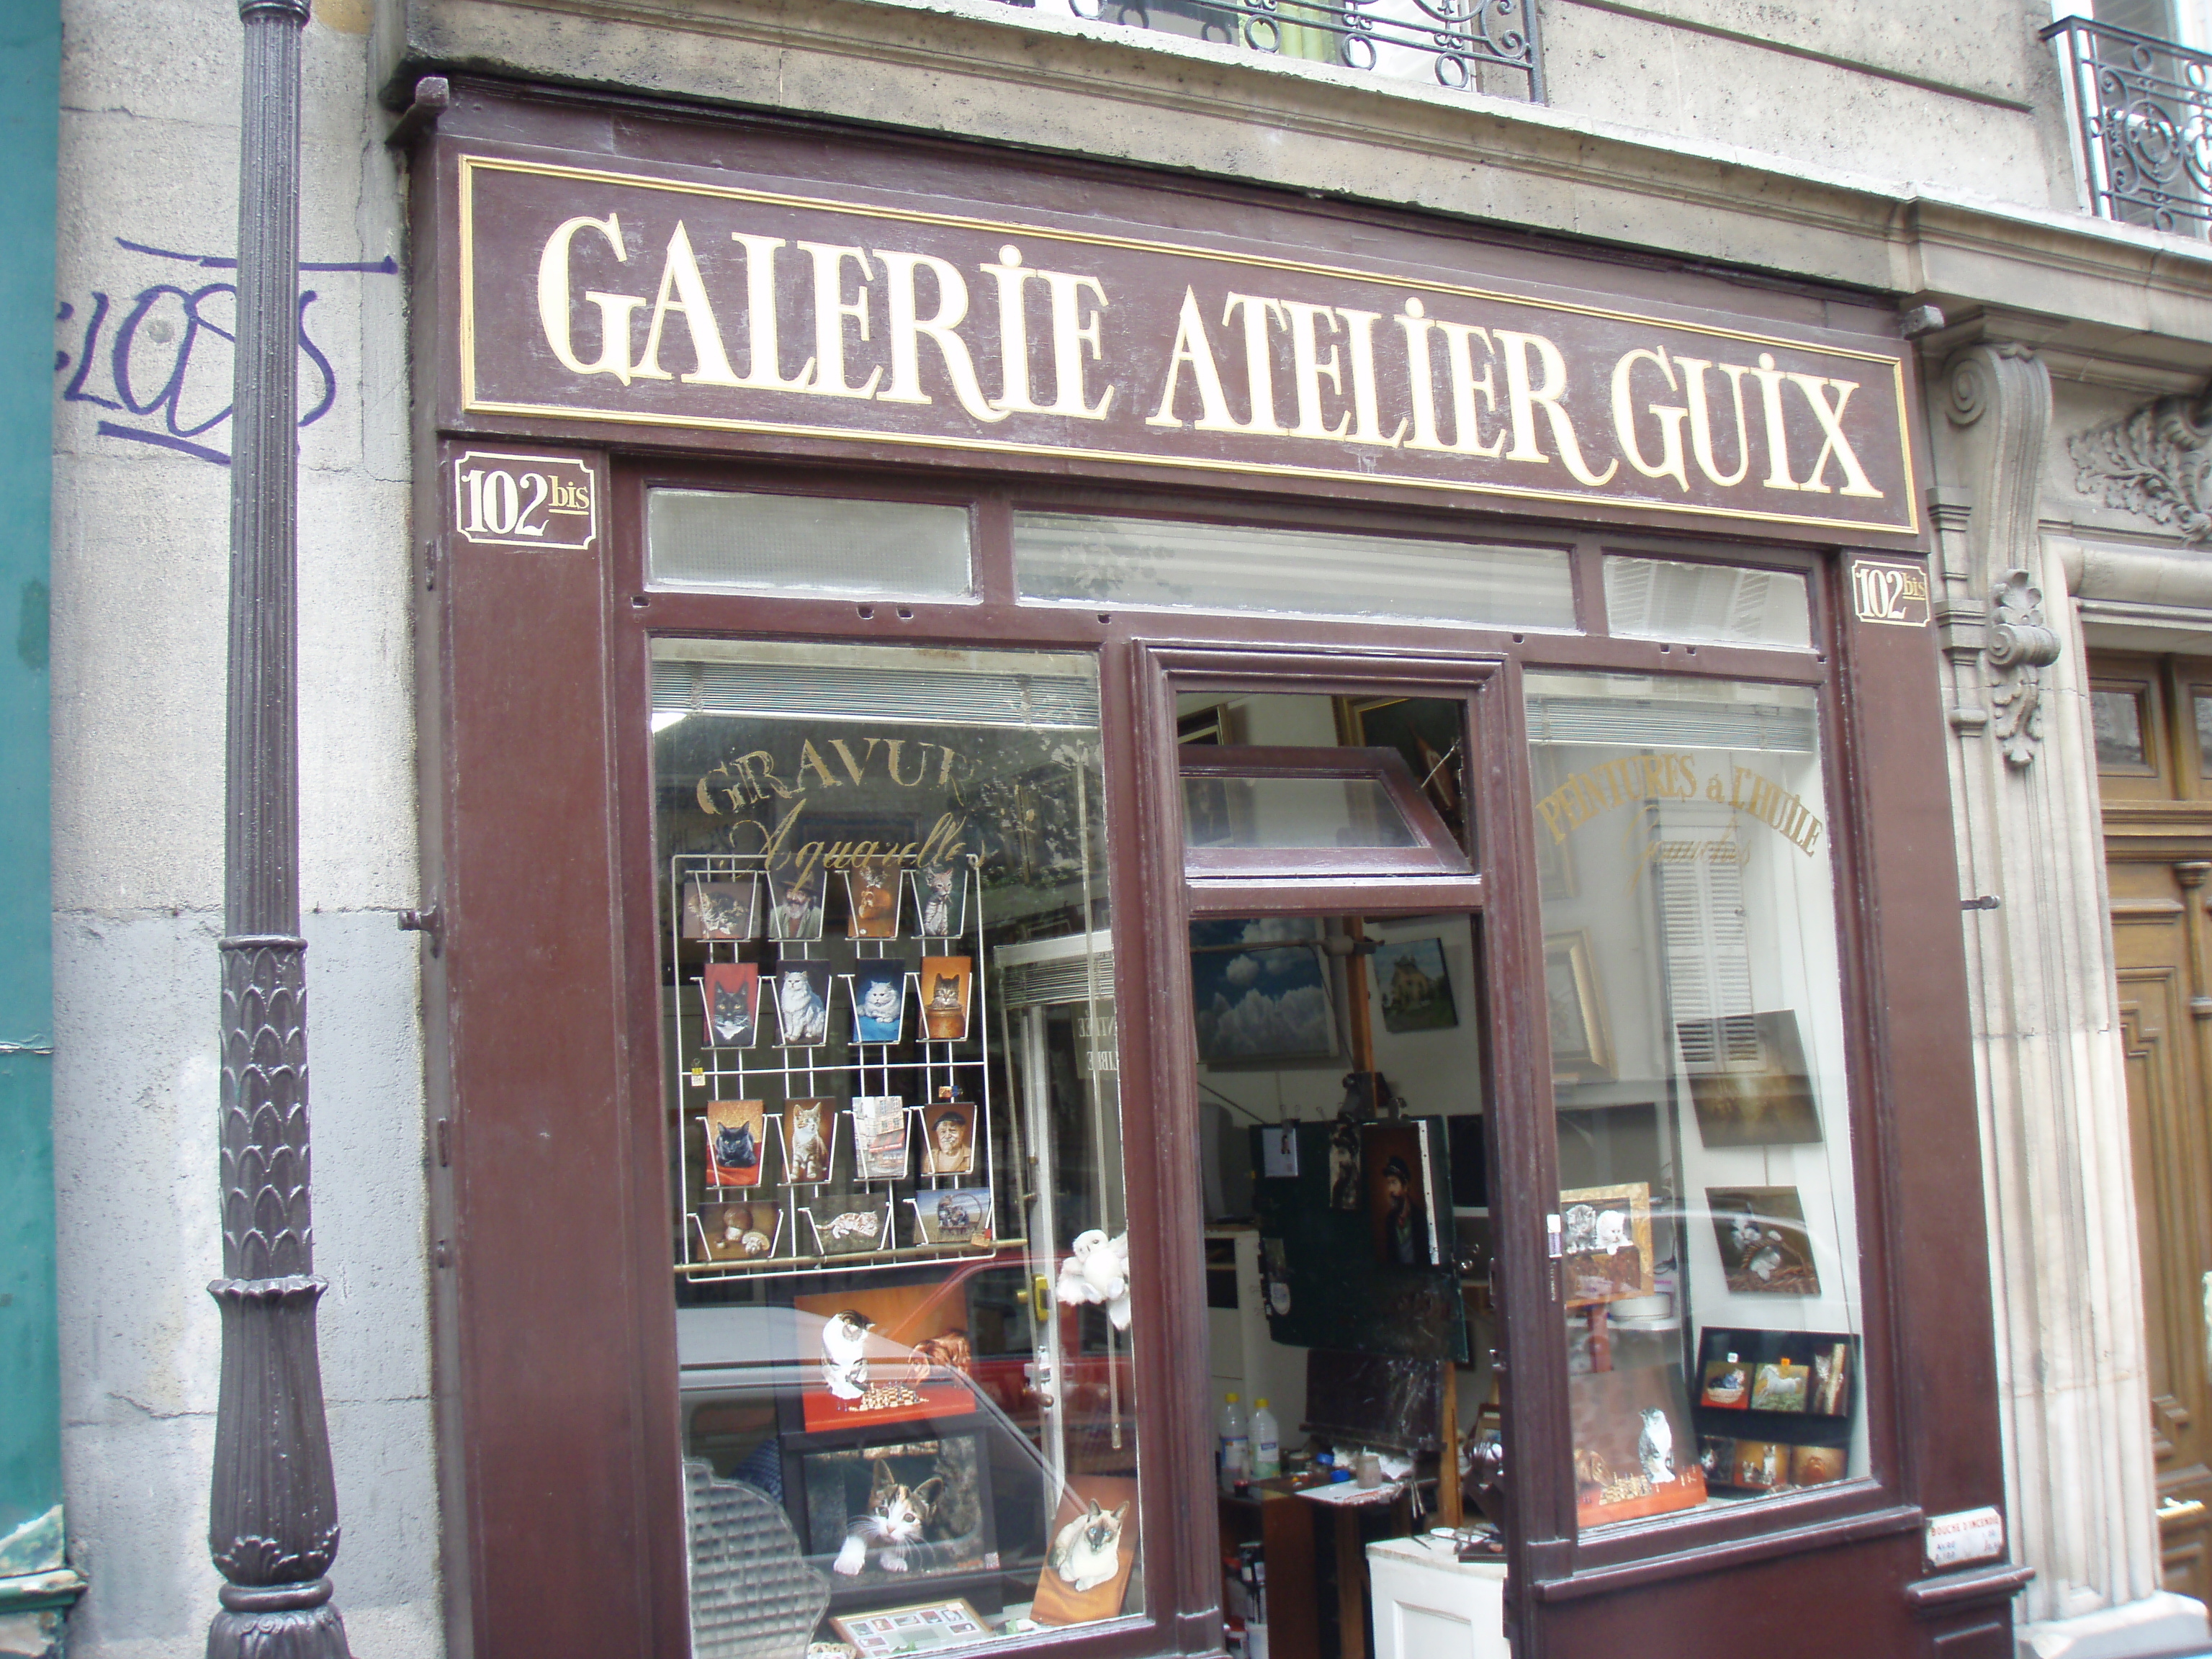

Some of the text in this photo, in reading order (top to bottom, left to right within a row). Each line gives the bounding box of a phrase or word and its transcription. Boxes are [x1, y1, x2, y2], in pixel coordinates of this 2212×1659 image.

[538, 212, 1884, 498] GALERIE ATELIER GUIX
[1535, 753, 1697, 845] PEINTURES
